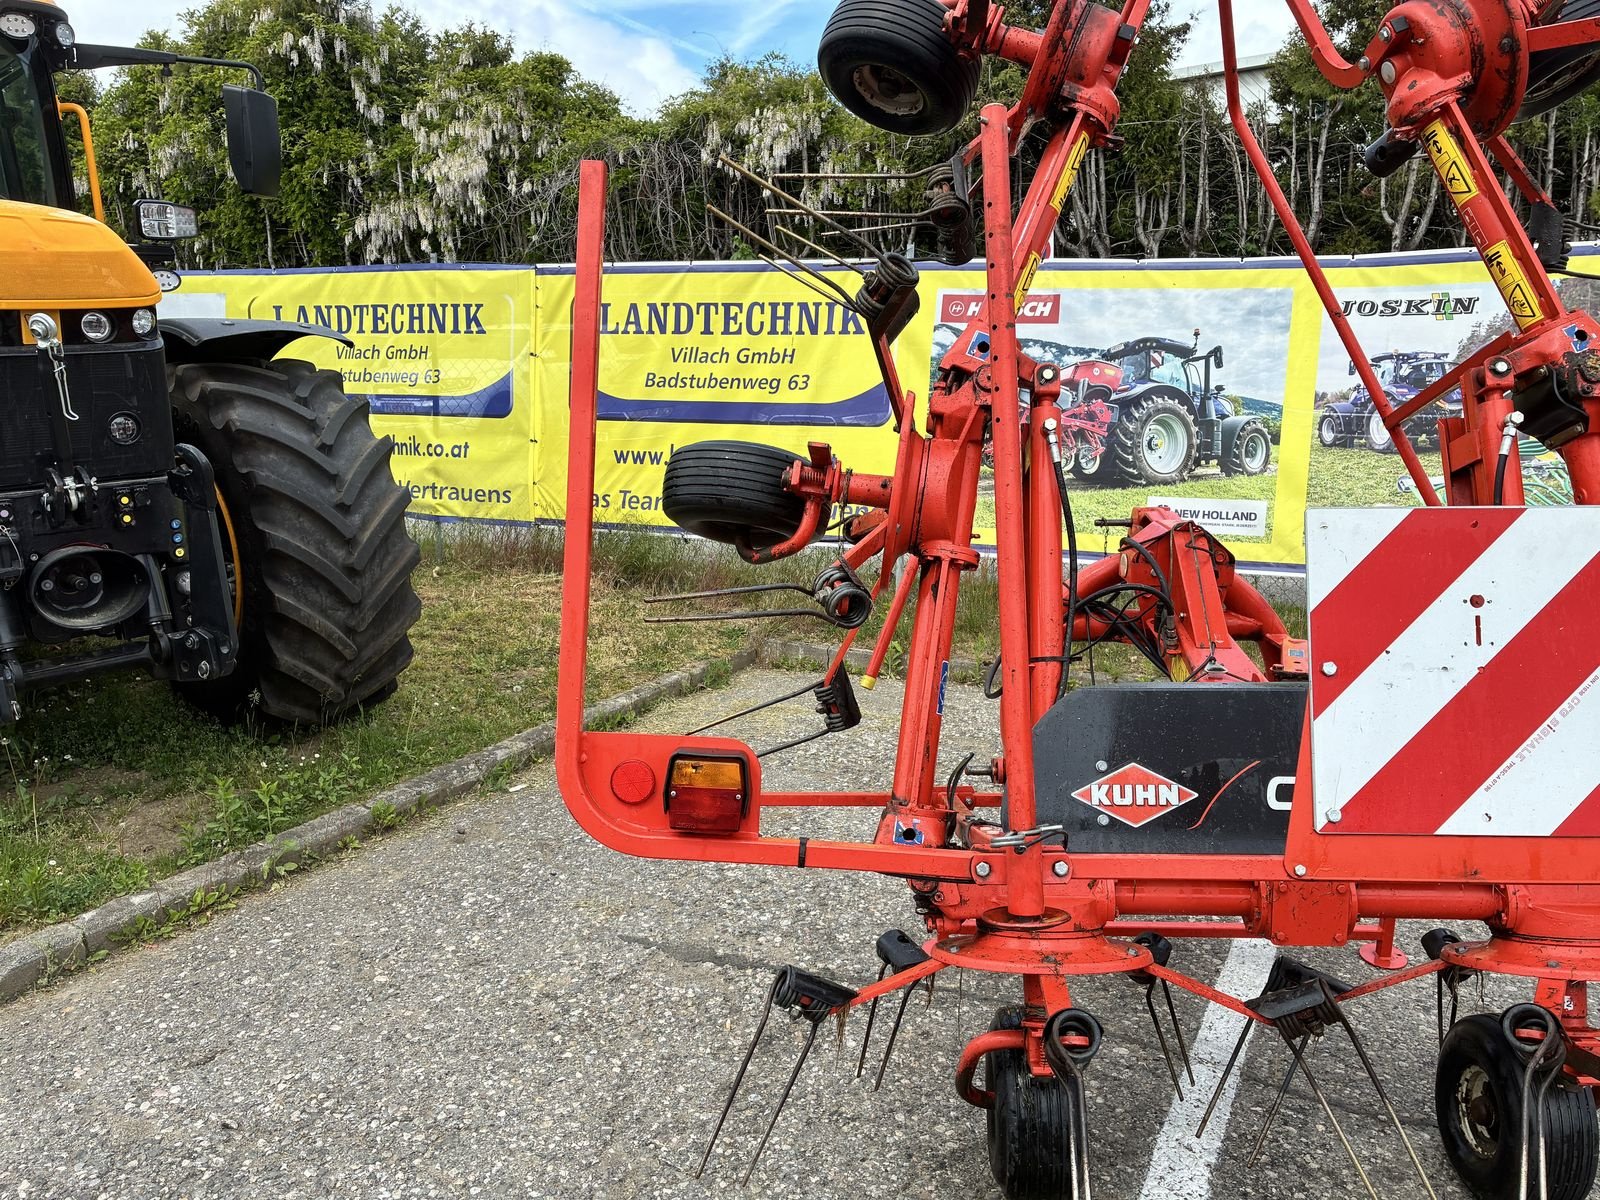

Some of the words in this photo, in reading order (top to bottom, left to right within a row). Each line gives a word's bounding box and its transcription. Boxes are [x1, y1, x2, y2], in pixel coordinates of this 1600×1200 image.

[1341, 297, 1479, 316] JOSKIN
[600, 301, 866, 336] LANDTECHNIK
[336, 344, 381, 361] Villach
[385, 345, 429, 361] GmbH
[670, 347, 730, 365] Villach
[737, 347, 796, 365] GmbH
[424, 369, 441, 384] 63
[644, 372, 782, 394] Badstubenweg
[787, 374, 810, 391] 63
[391, 433, 470, 459] hnik.co.at
[593, 493, 611, 509] as
[1174, 508, 1200, 519] NEW
[1202, 510, 1258, 522] HOLLAND
[1590, 674, 1600, 685] DIN
[1558, 695, 1581, 719] CFG
[1090, 783, 1180, 807] KUHN
